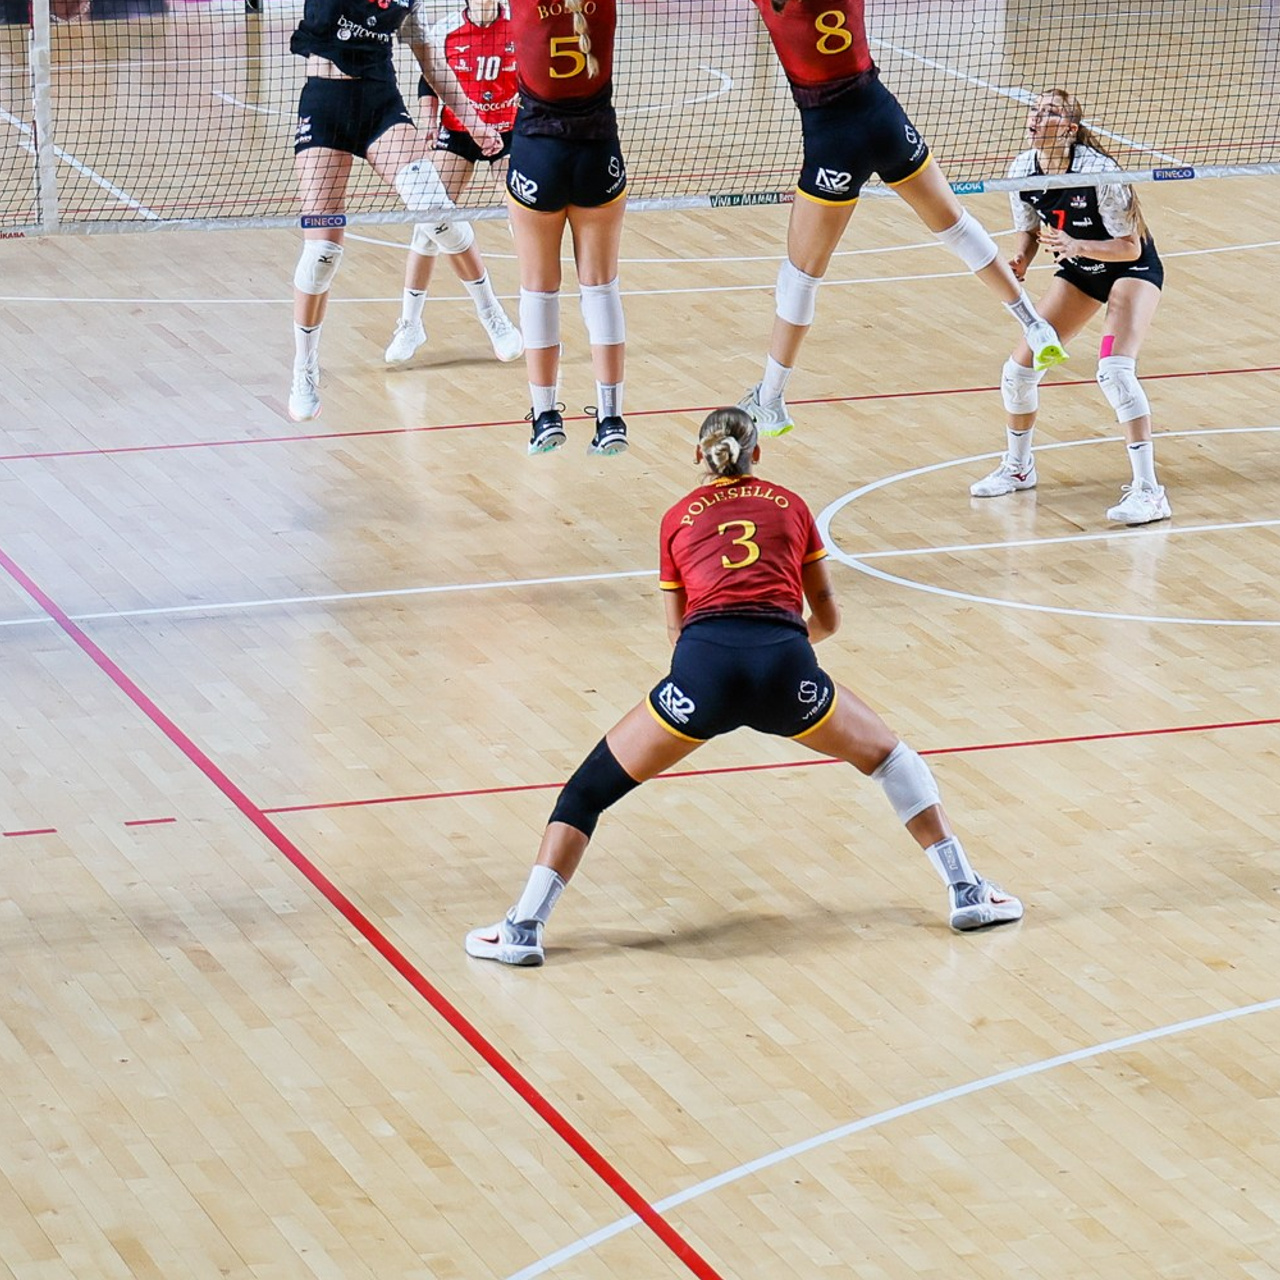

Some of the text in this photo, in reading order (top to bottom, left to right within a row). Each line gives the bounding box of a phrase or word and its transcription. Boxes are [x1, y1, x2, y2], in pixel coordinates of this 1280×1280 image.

[814, 10, 853, 55] 8
[475, 55, 501, 81] 10
[549, 35, 587, 79] 5
[1155, 169, 1192, 179] FINECO
[304, 216, 343, 227] FINECO
[1051, 209, 1068, 231] 7
[680, 485, 790, 527] POLESELLO
[717, 519, 761, 569] 3
